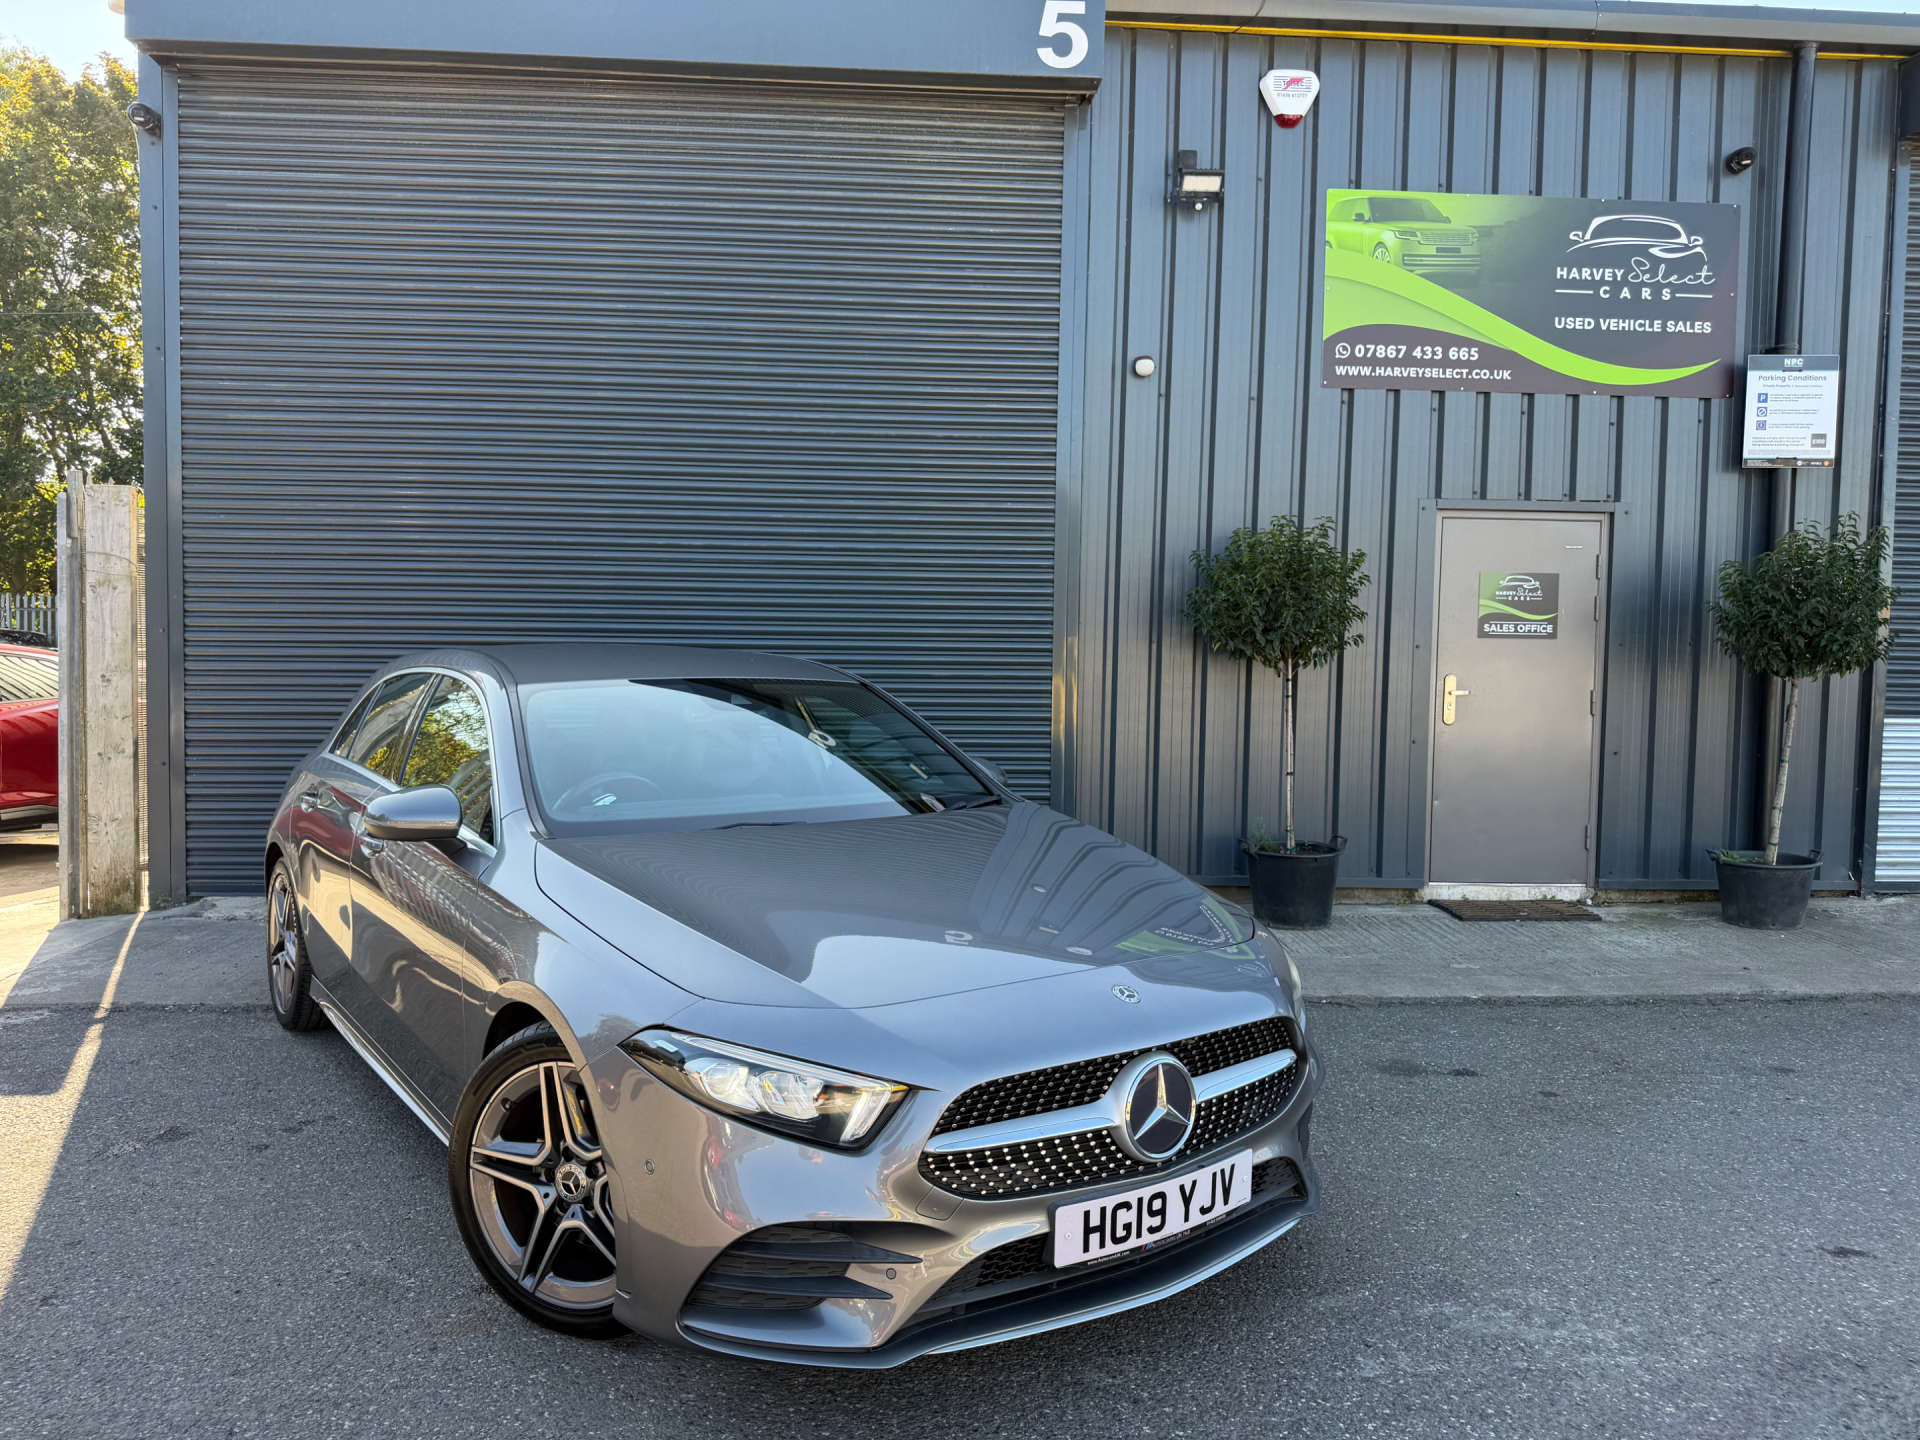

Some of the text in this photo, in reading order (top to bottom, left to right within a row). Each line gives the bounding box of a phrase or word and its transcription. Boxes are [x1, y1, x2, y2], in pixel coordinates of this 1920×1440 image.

[1037, 0, 1088, 68] 5
[1556, 256, 1716, 285] HARVEY Select
[1599, 286, 1672, 300] CARS
[1554, 316, 1712, 333] USED VEHICLE SALES
[1354, 344, 1479, 361] 07867 433 665
[1335, 365, 1512, 380] WWW.HARVEYSELECT.CO.UK
[1758, 374, 1827, 383] Parking Conditions
[1483, 623, 1553, 633] SALES OFFICE
[1083, 1163, 1236, 1254] HG19 YJV
